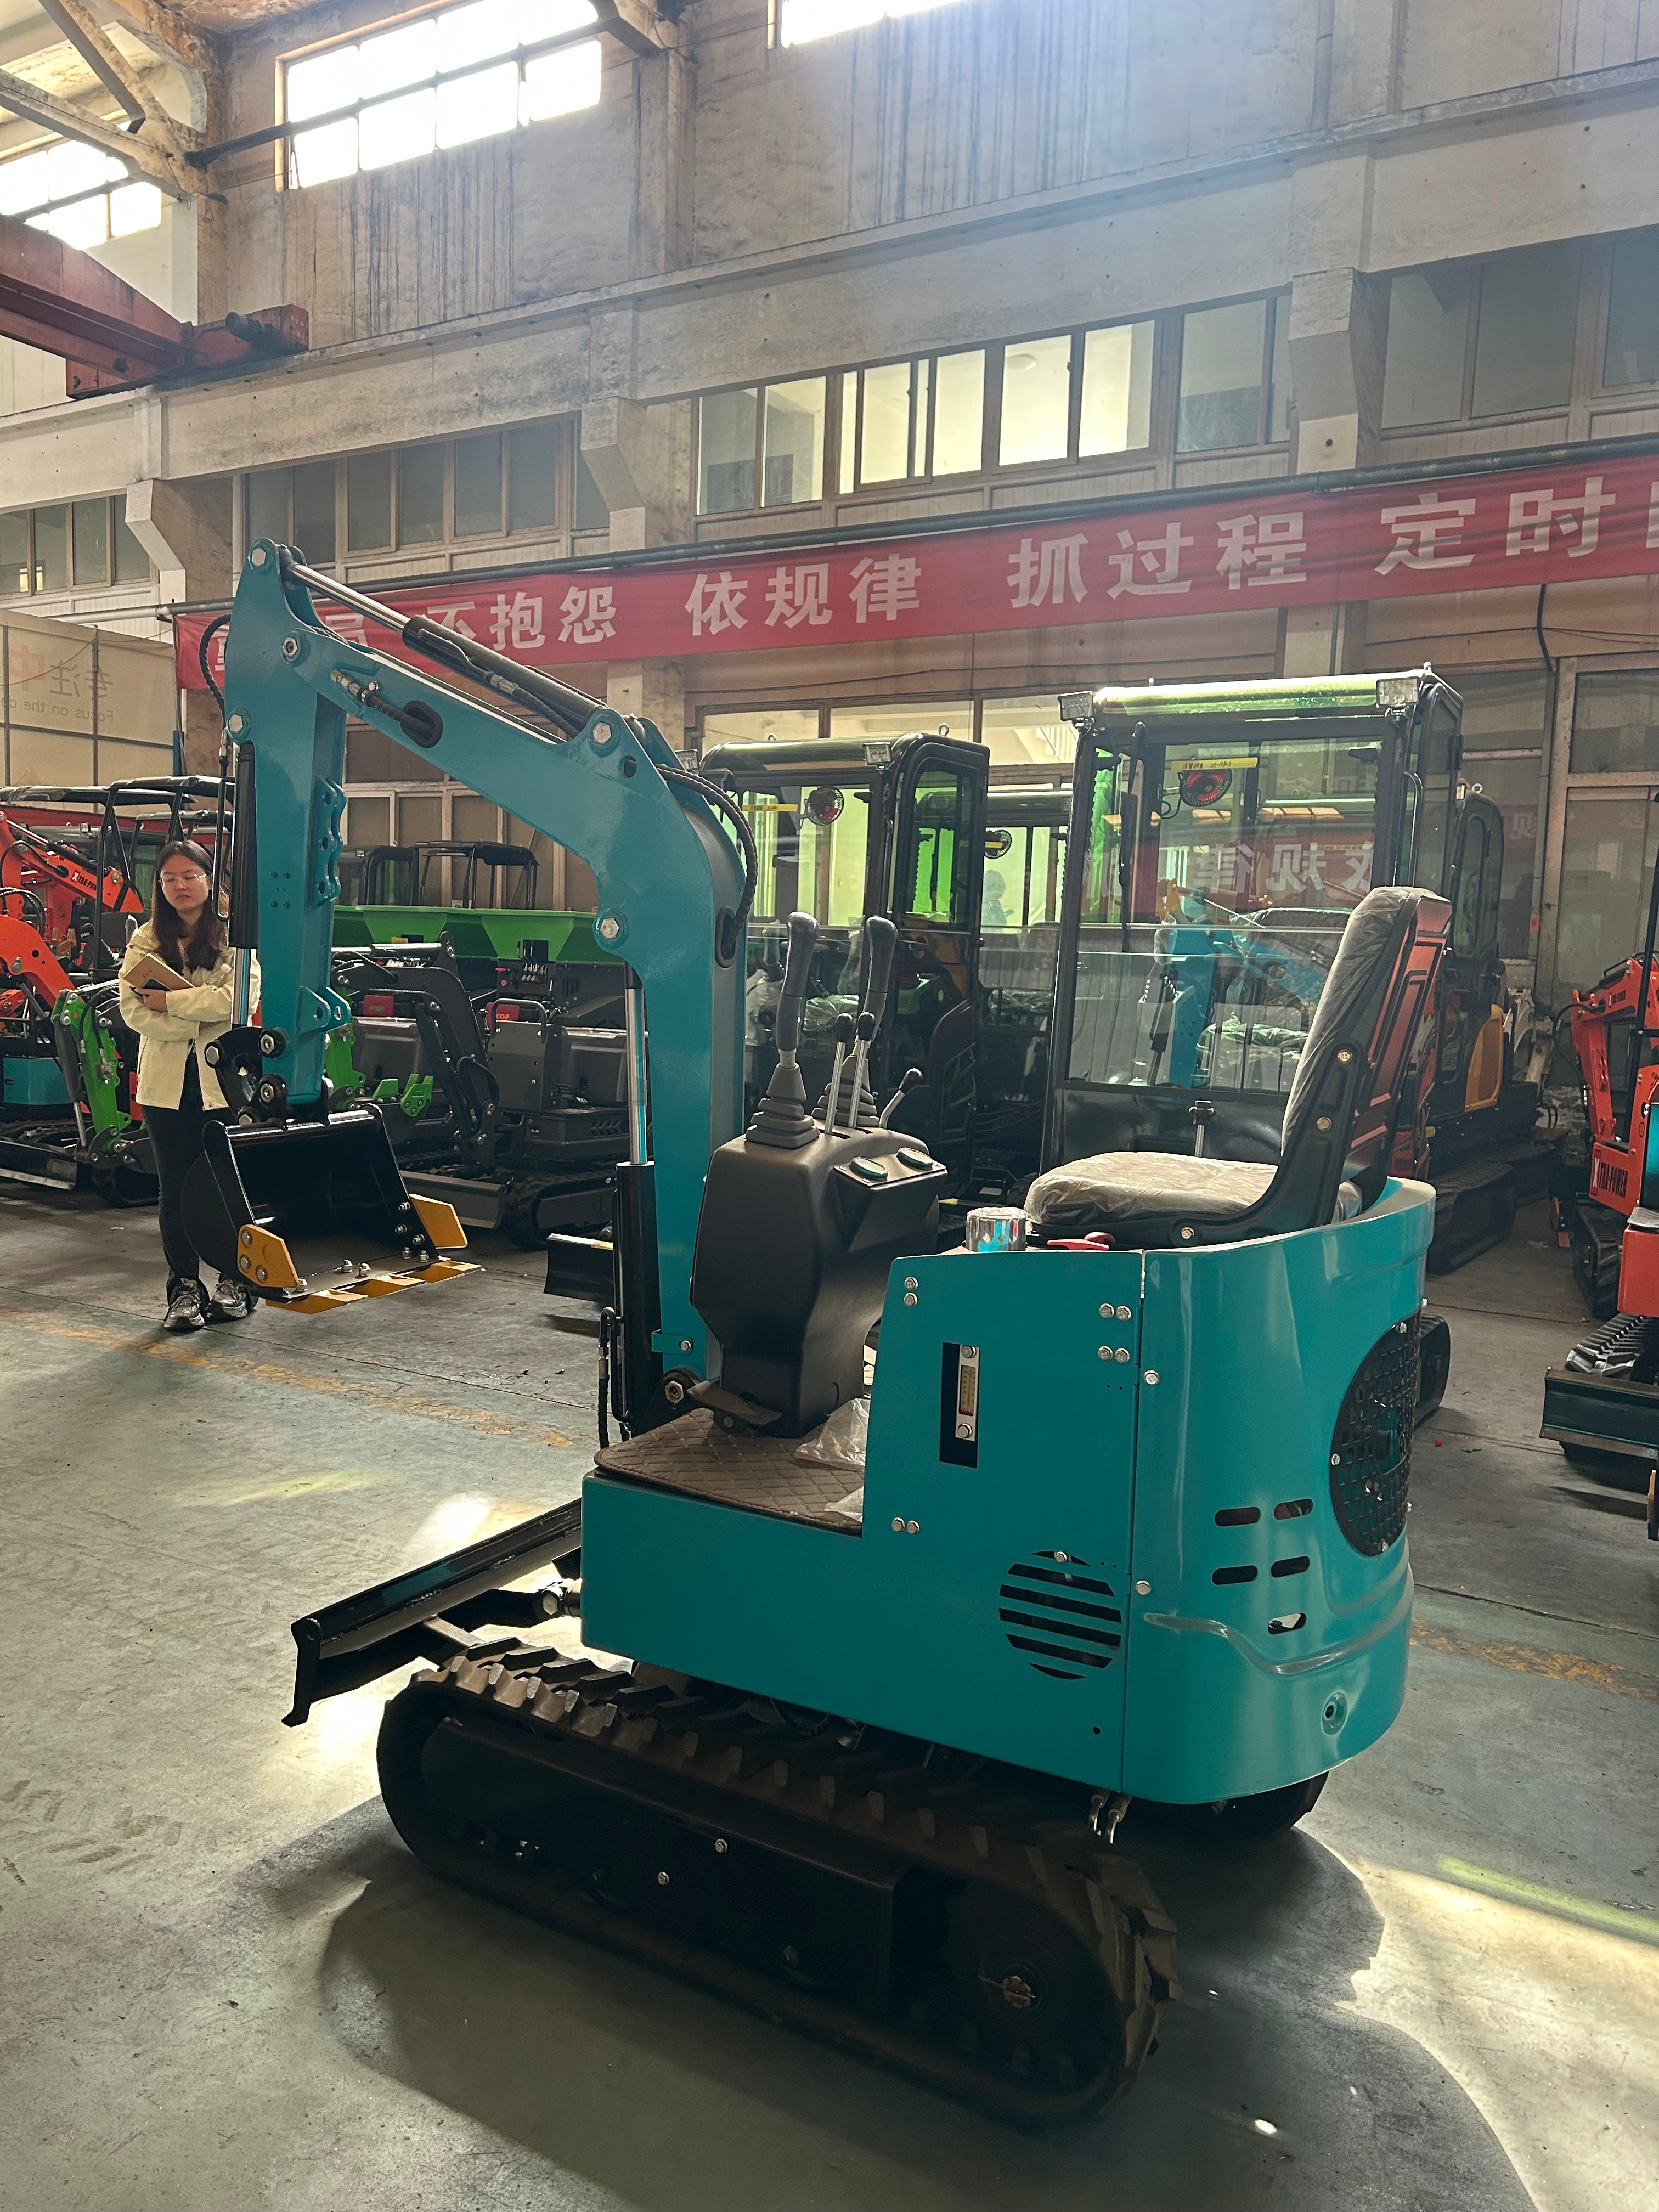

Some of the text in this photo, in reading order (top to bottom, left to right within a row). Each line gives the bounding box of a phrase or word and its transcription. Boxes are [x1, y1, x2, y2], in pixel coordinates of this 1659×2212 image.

[426, 586, 617, 651] 不抱怨
[684, 553, 922, 636] 依规律
[1007, 511, 1307, 608] 抓过程
[1374, 476, 1659, 575] 定时
[1592, 1157, 1629, 1198] XTRA-POWER
